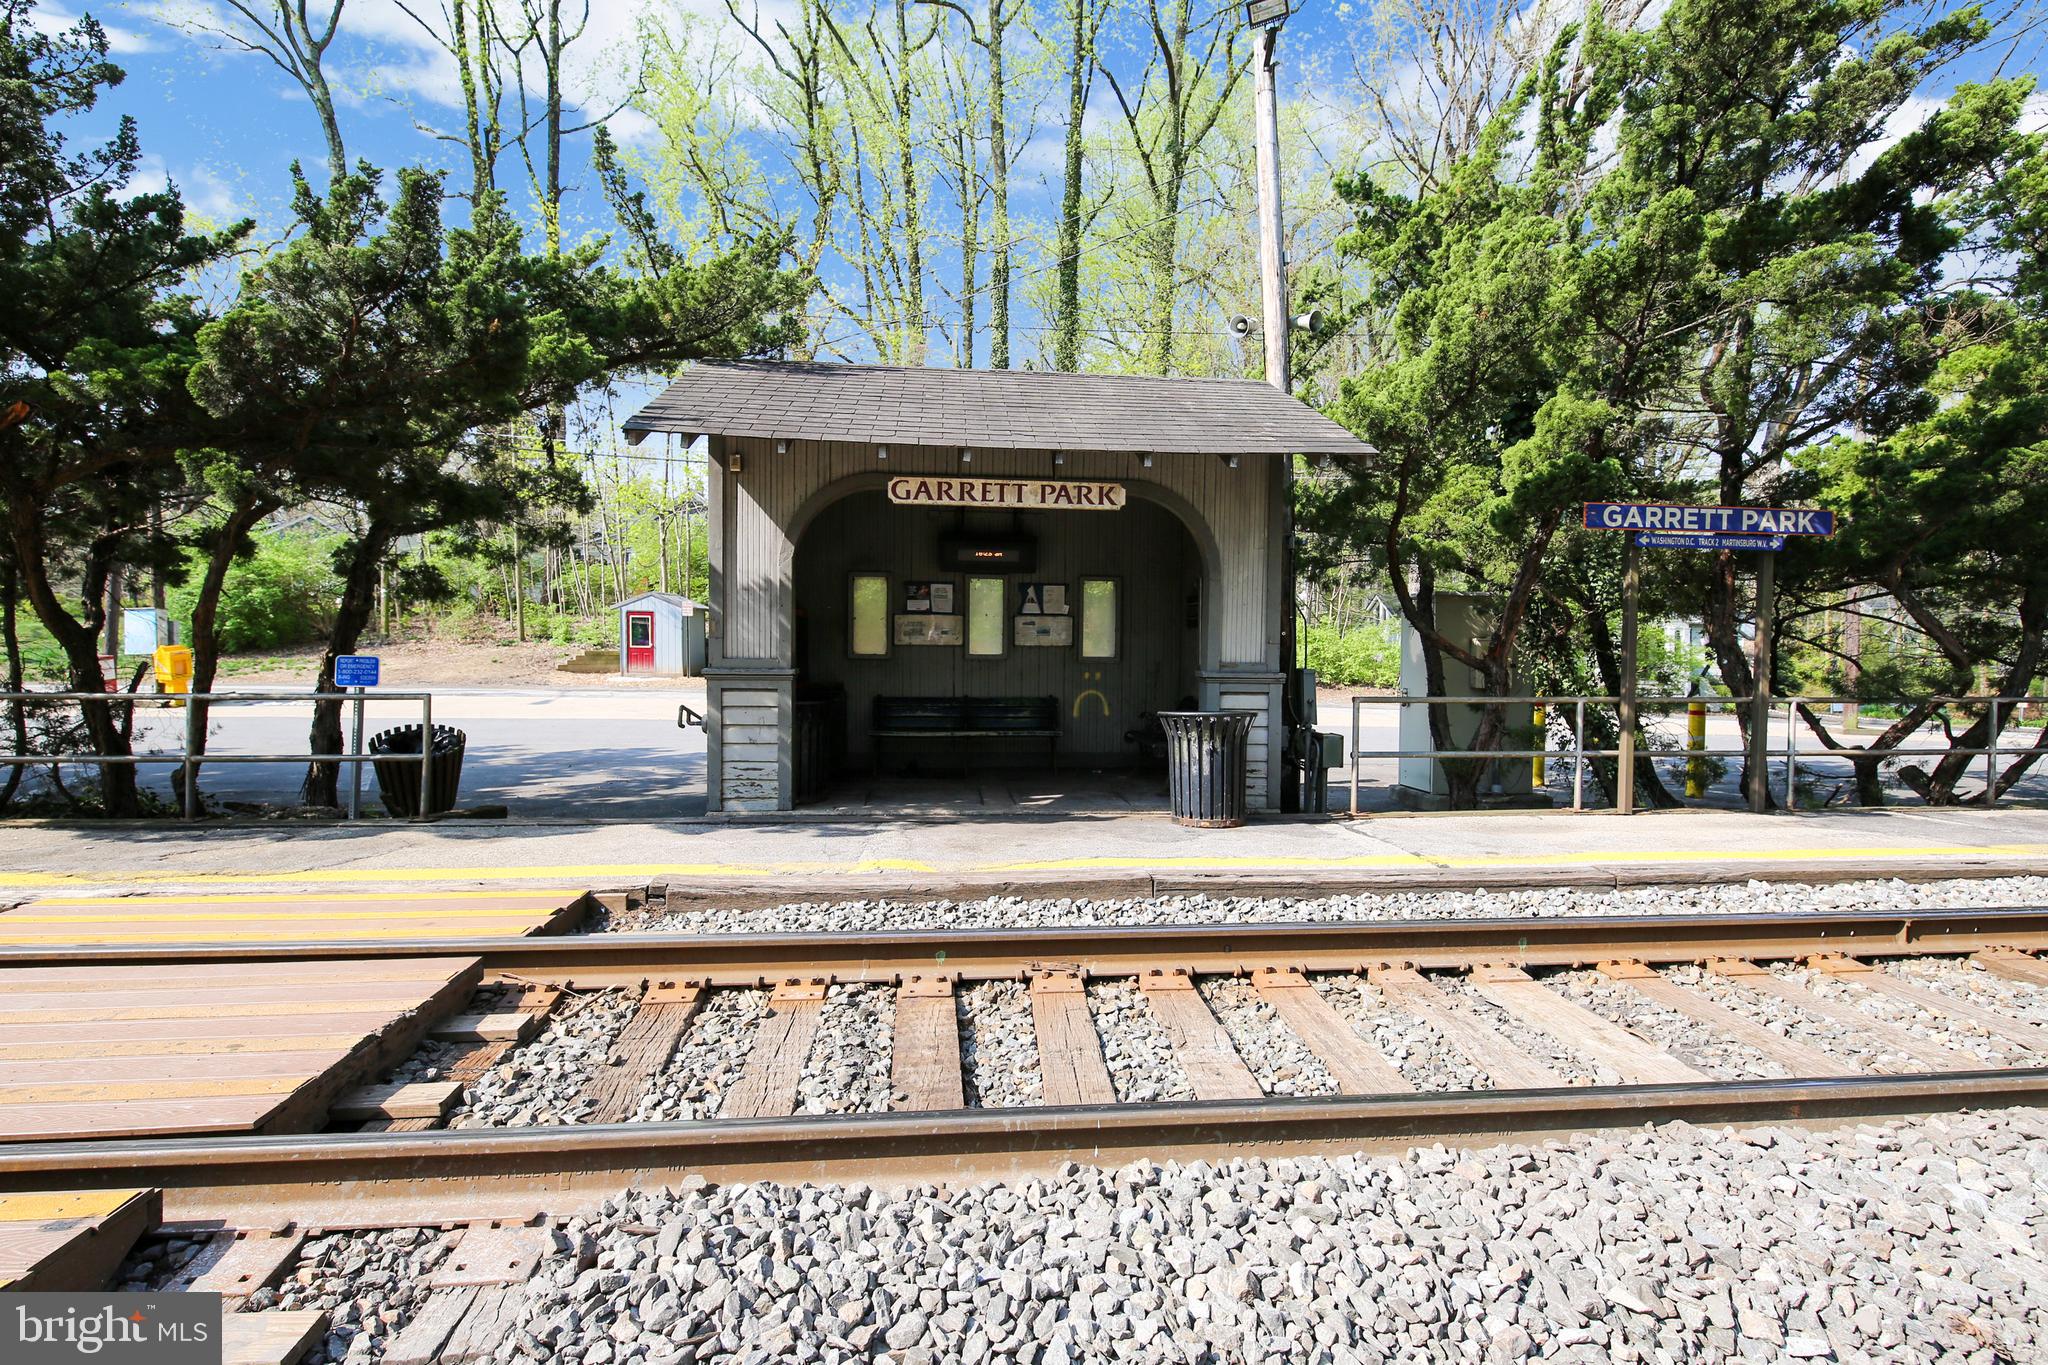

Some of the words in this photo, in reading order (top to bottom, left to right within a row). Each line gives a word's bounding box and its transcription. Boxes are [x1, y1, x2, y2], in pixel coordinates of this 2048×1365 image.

[890, 479, 1028, 503] GARRETT
[1040, 484, 1118, 506] PARK
[1603, 505, 1734, 530] GARRETT
[1742, 510, 1815, 533] PARK
[1651, 537, 1685, 545] WASHINGTON
[1698, 538, 1715, 546] TRACK
[1721, 539, 1756, 547] MARTINSBURG
